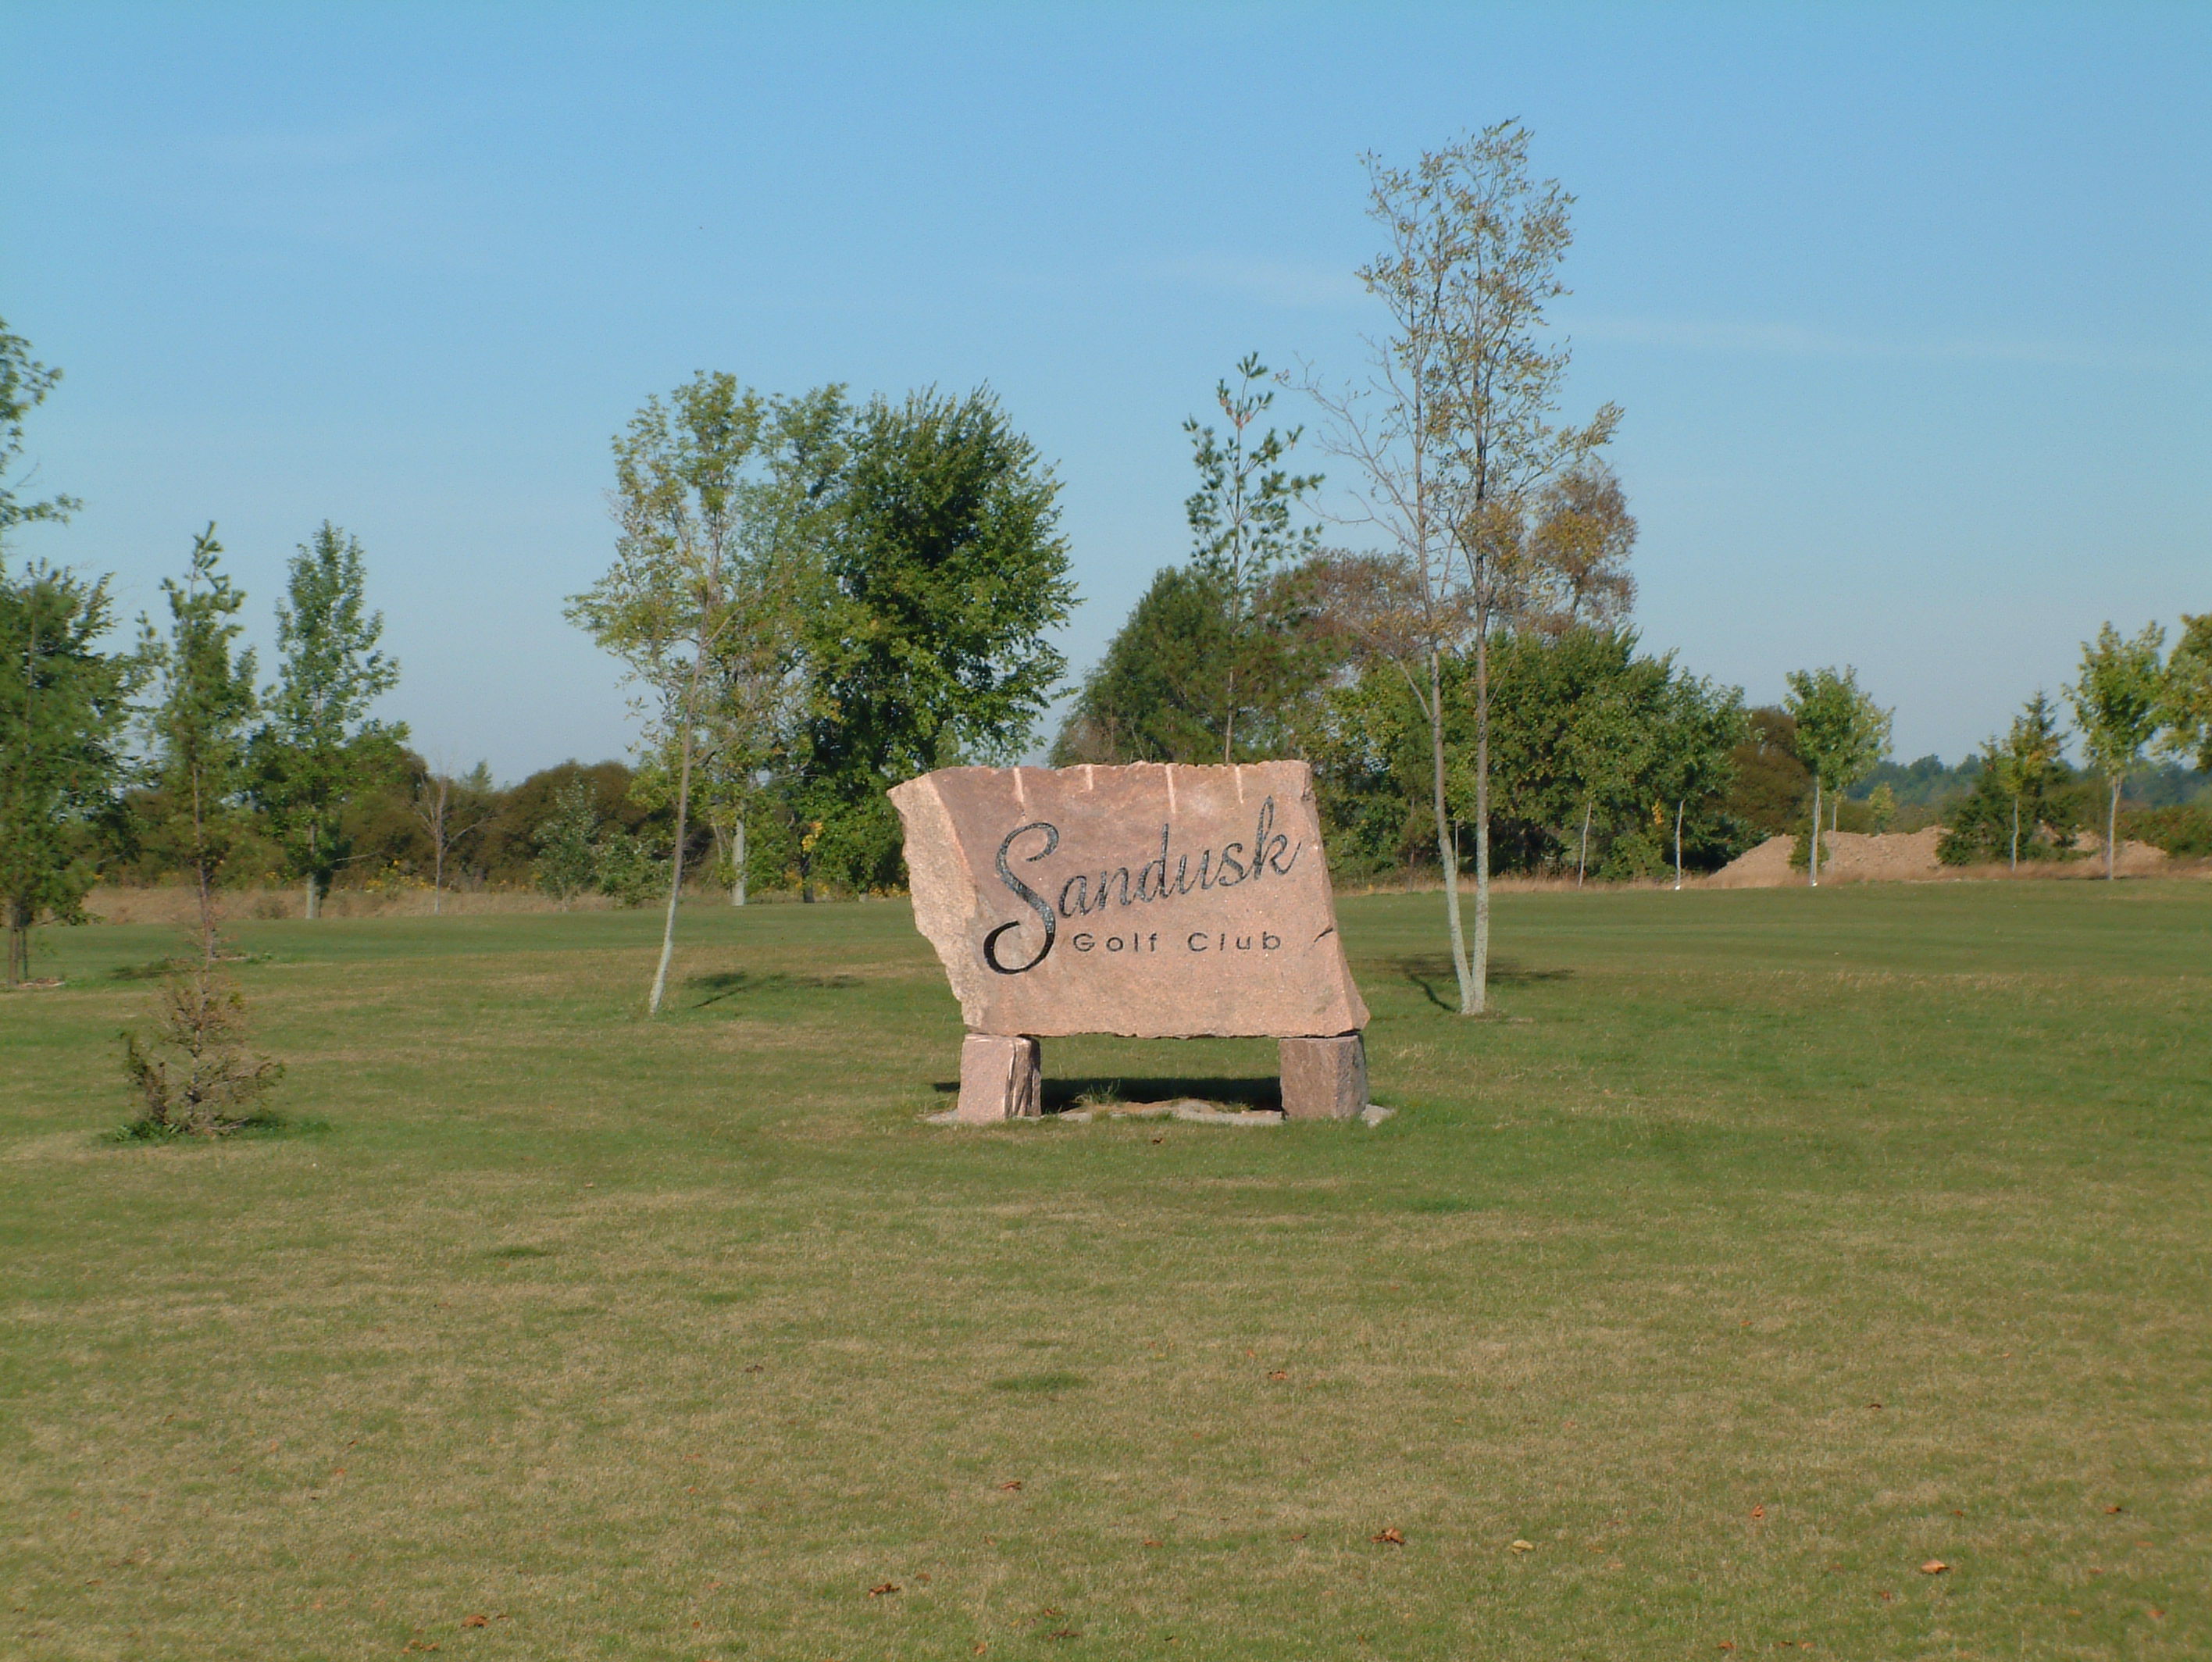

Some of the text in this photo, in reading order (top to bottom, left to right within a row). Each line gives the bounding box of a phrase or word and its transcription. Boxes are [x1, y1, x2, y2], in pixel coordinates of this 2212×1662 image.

[983, 796, 1302, 974] Sandusk
[1072, 932, 1281, 953] Golf Club
